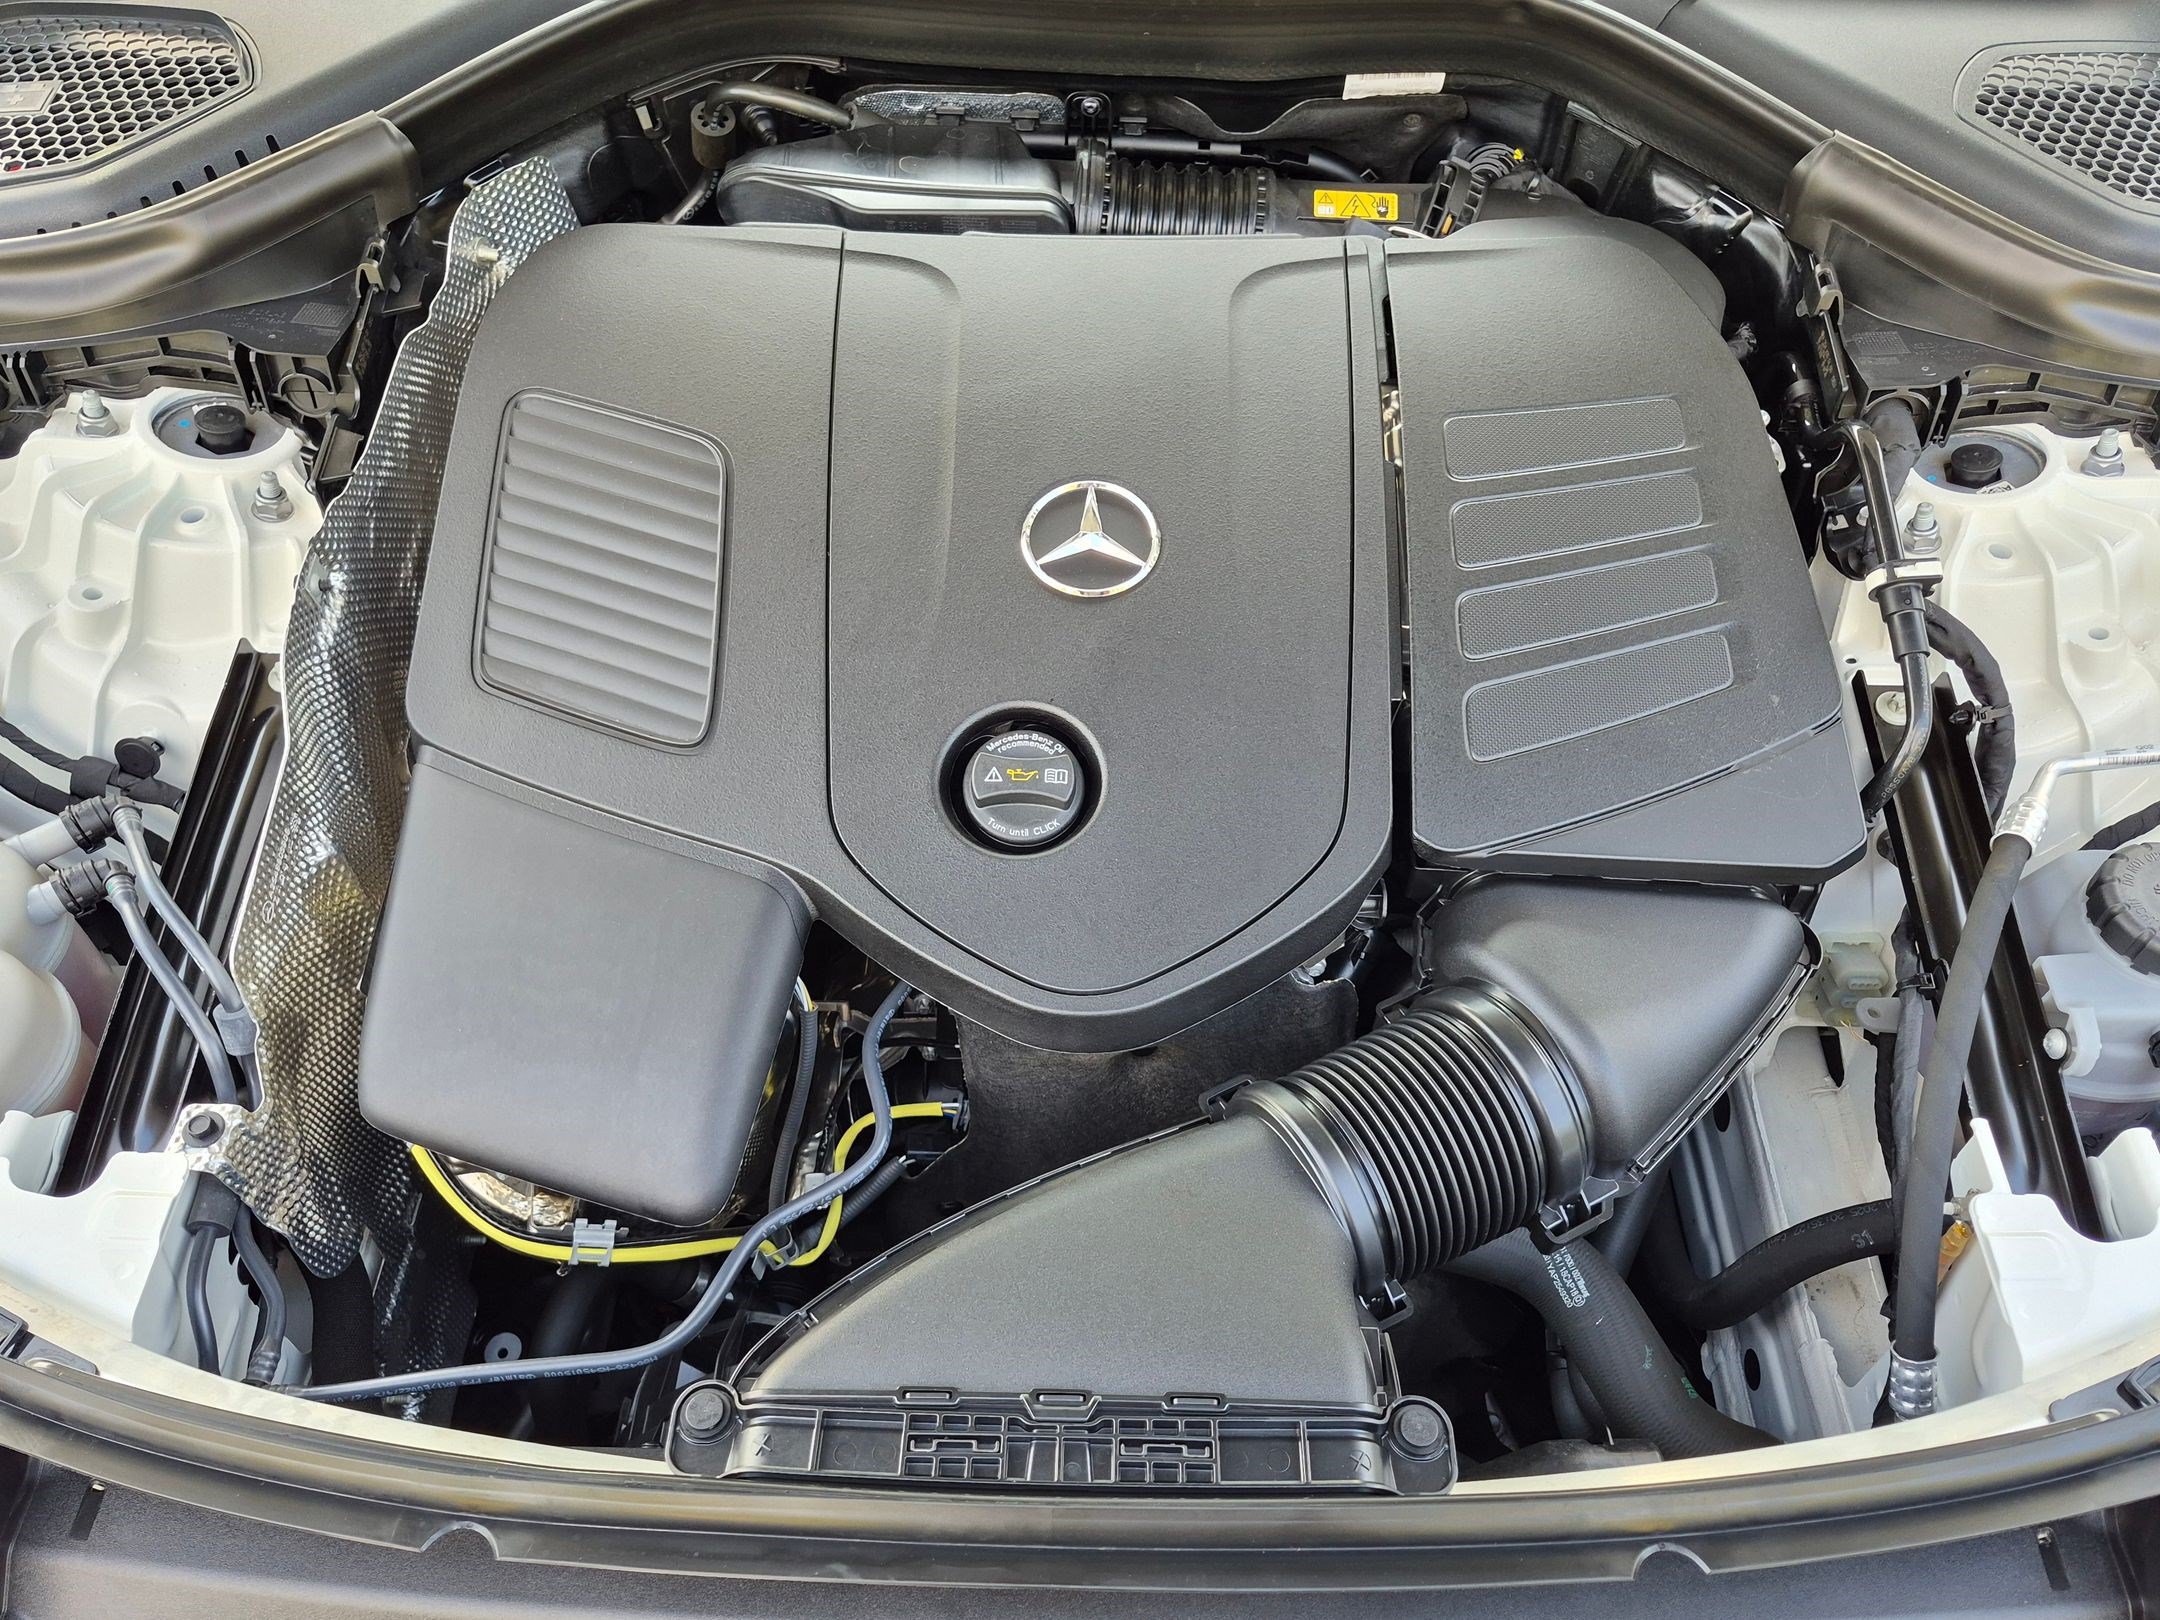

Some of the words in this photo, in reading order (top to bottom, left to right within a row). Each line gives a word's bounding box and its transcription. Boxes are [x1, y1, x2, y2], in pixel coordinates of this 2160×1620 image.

[986, 733, 1053, 751] Mercedes-Benz
[1053, 743, 1066, 753] Oil
[998, 740, 1056, 755] recommended
[987, 818, 1006, 833] Turn
[1009, 825, 1029, 837] until
[1033, 818, 1061, 835] CLICK
